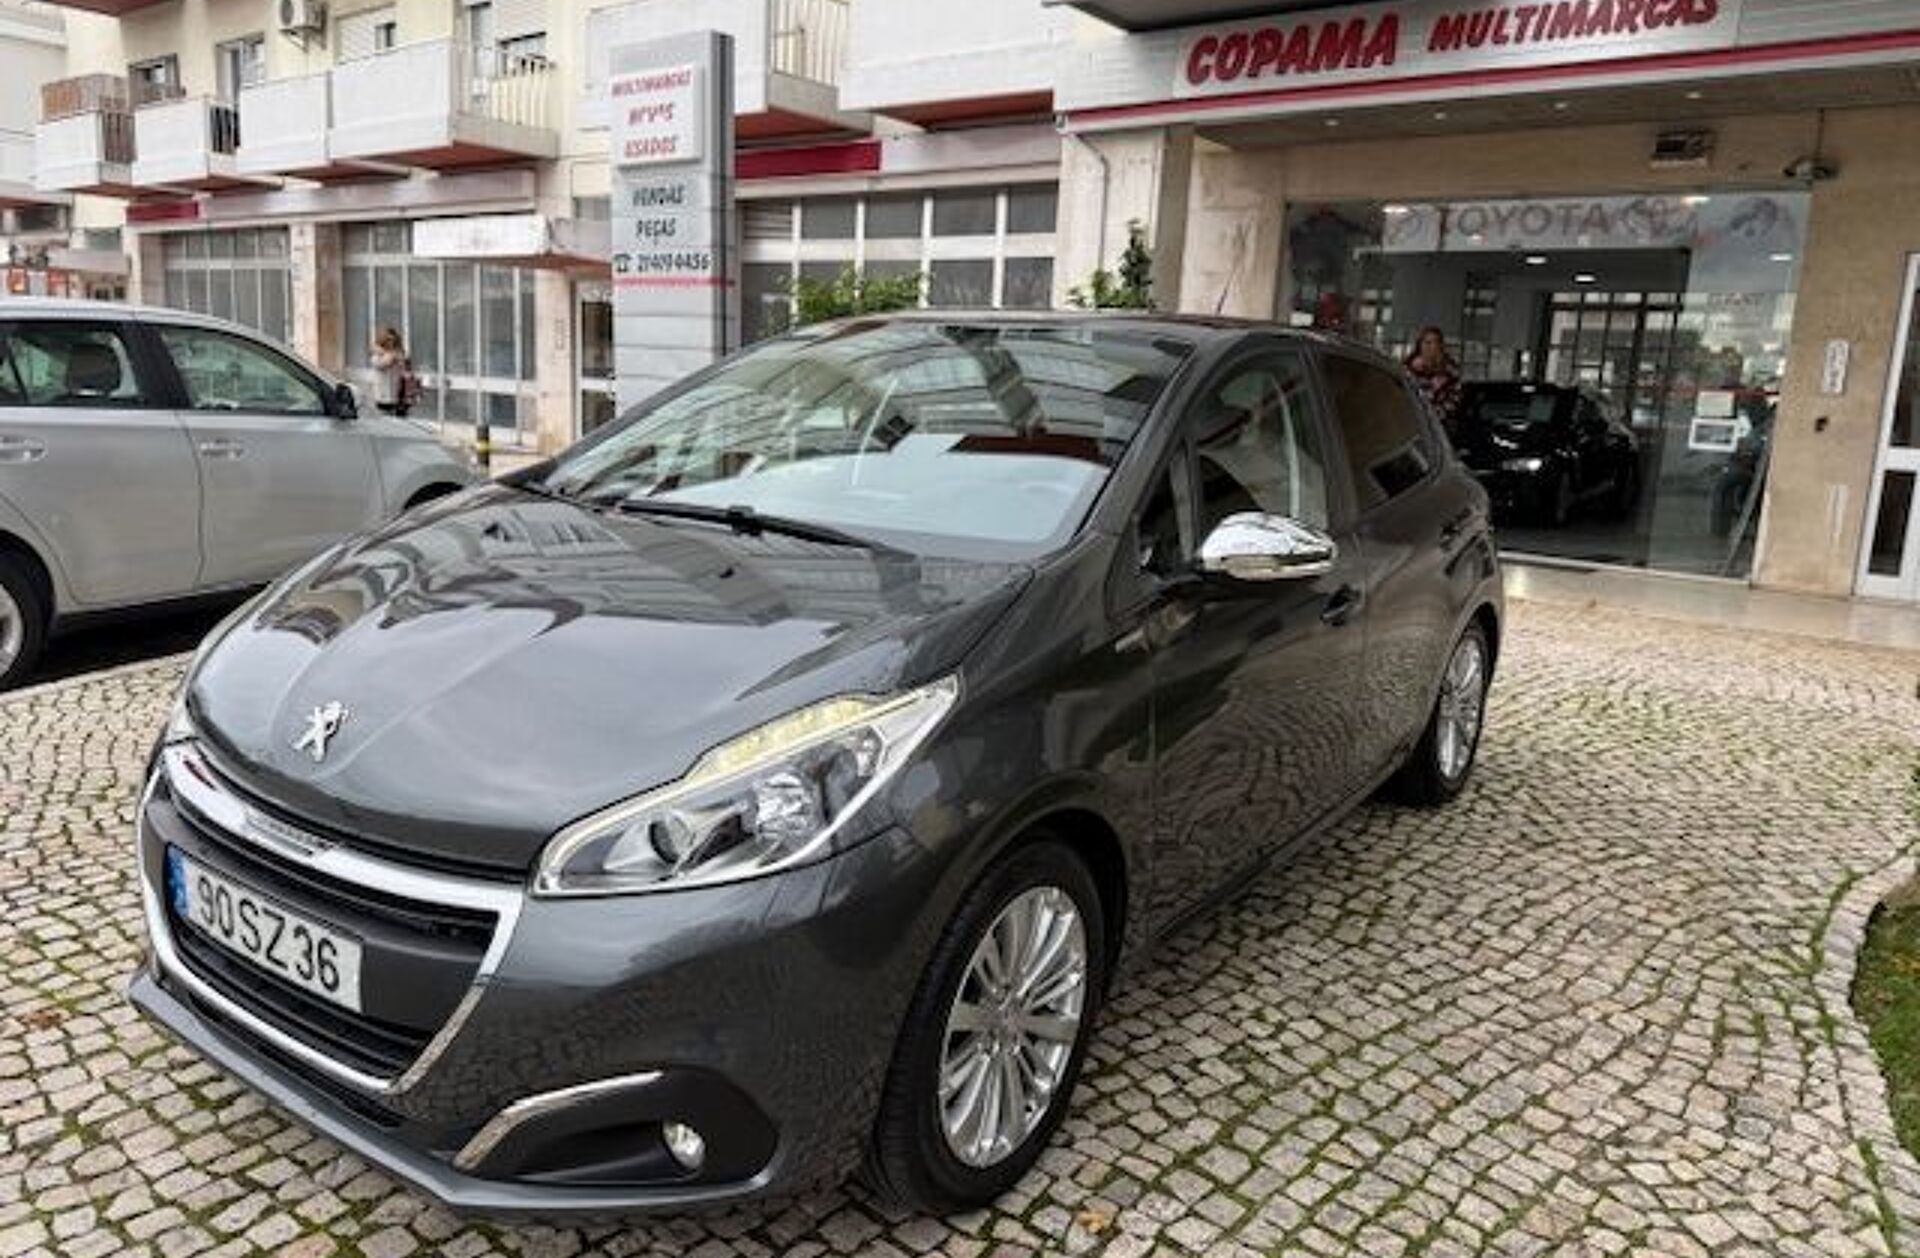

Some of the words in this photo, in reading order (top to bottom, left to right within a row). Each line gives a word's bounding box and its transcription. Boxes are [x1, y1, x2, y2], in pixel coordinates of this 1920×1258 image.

[1187, 13, 1398, 85] COPAMA
[1427, 0, 1718, 52] MULTIMARCAS
[633, 184, 684, 207] VENDAS
[635, 217, 676, 245] PEÇAS
